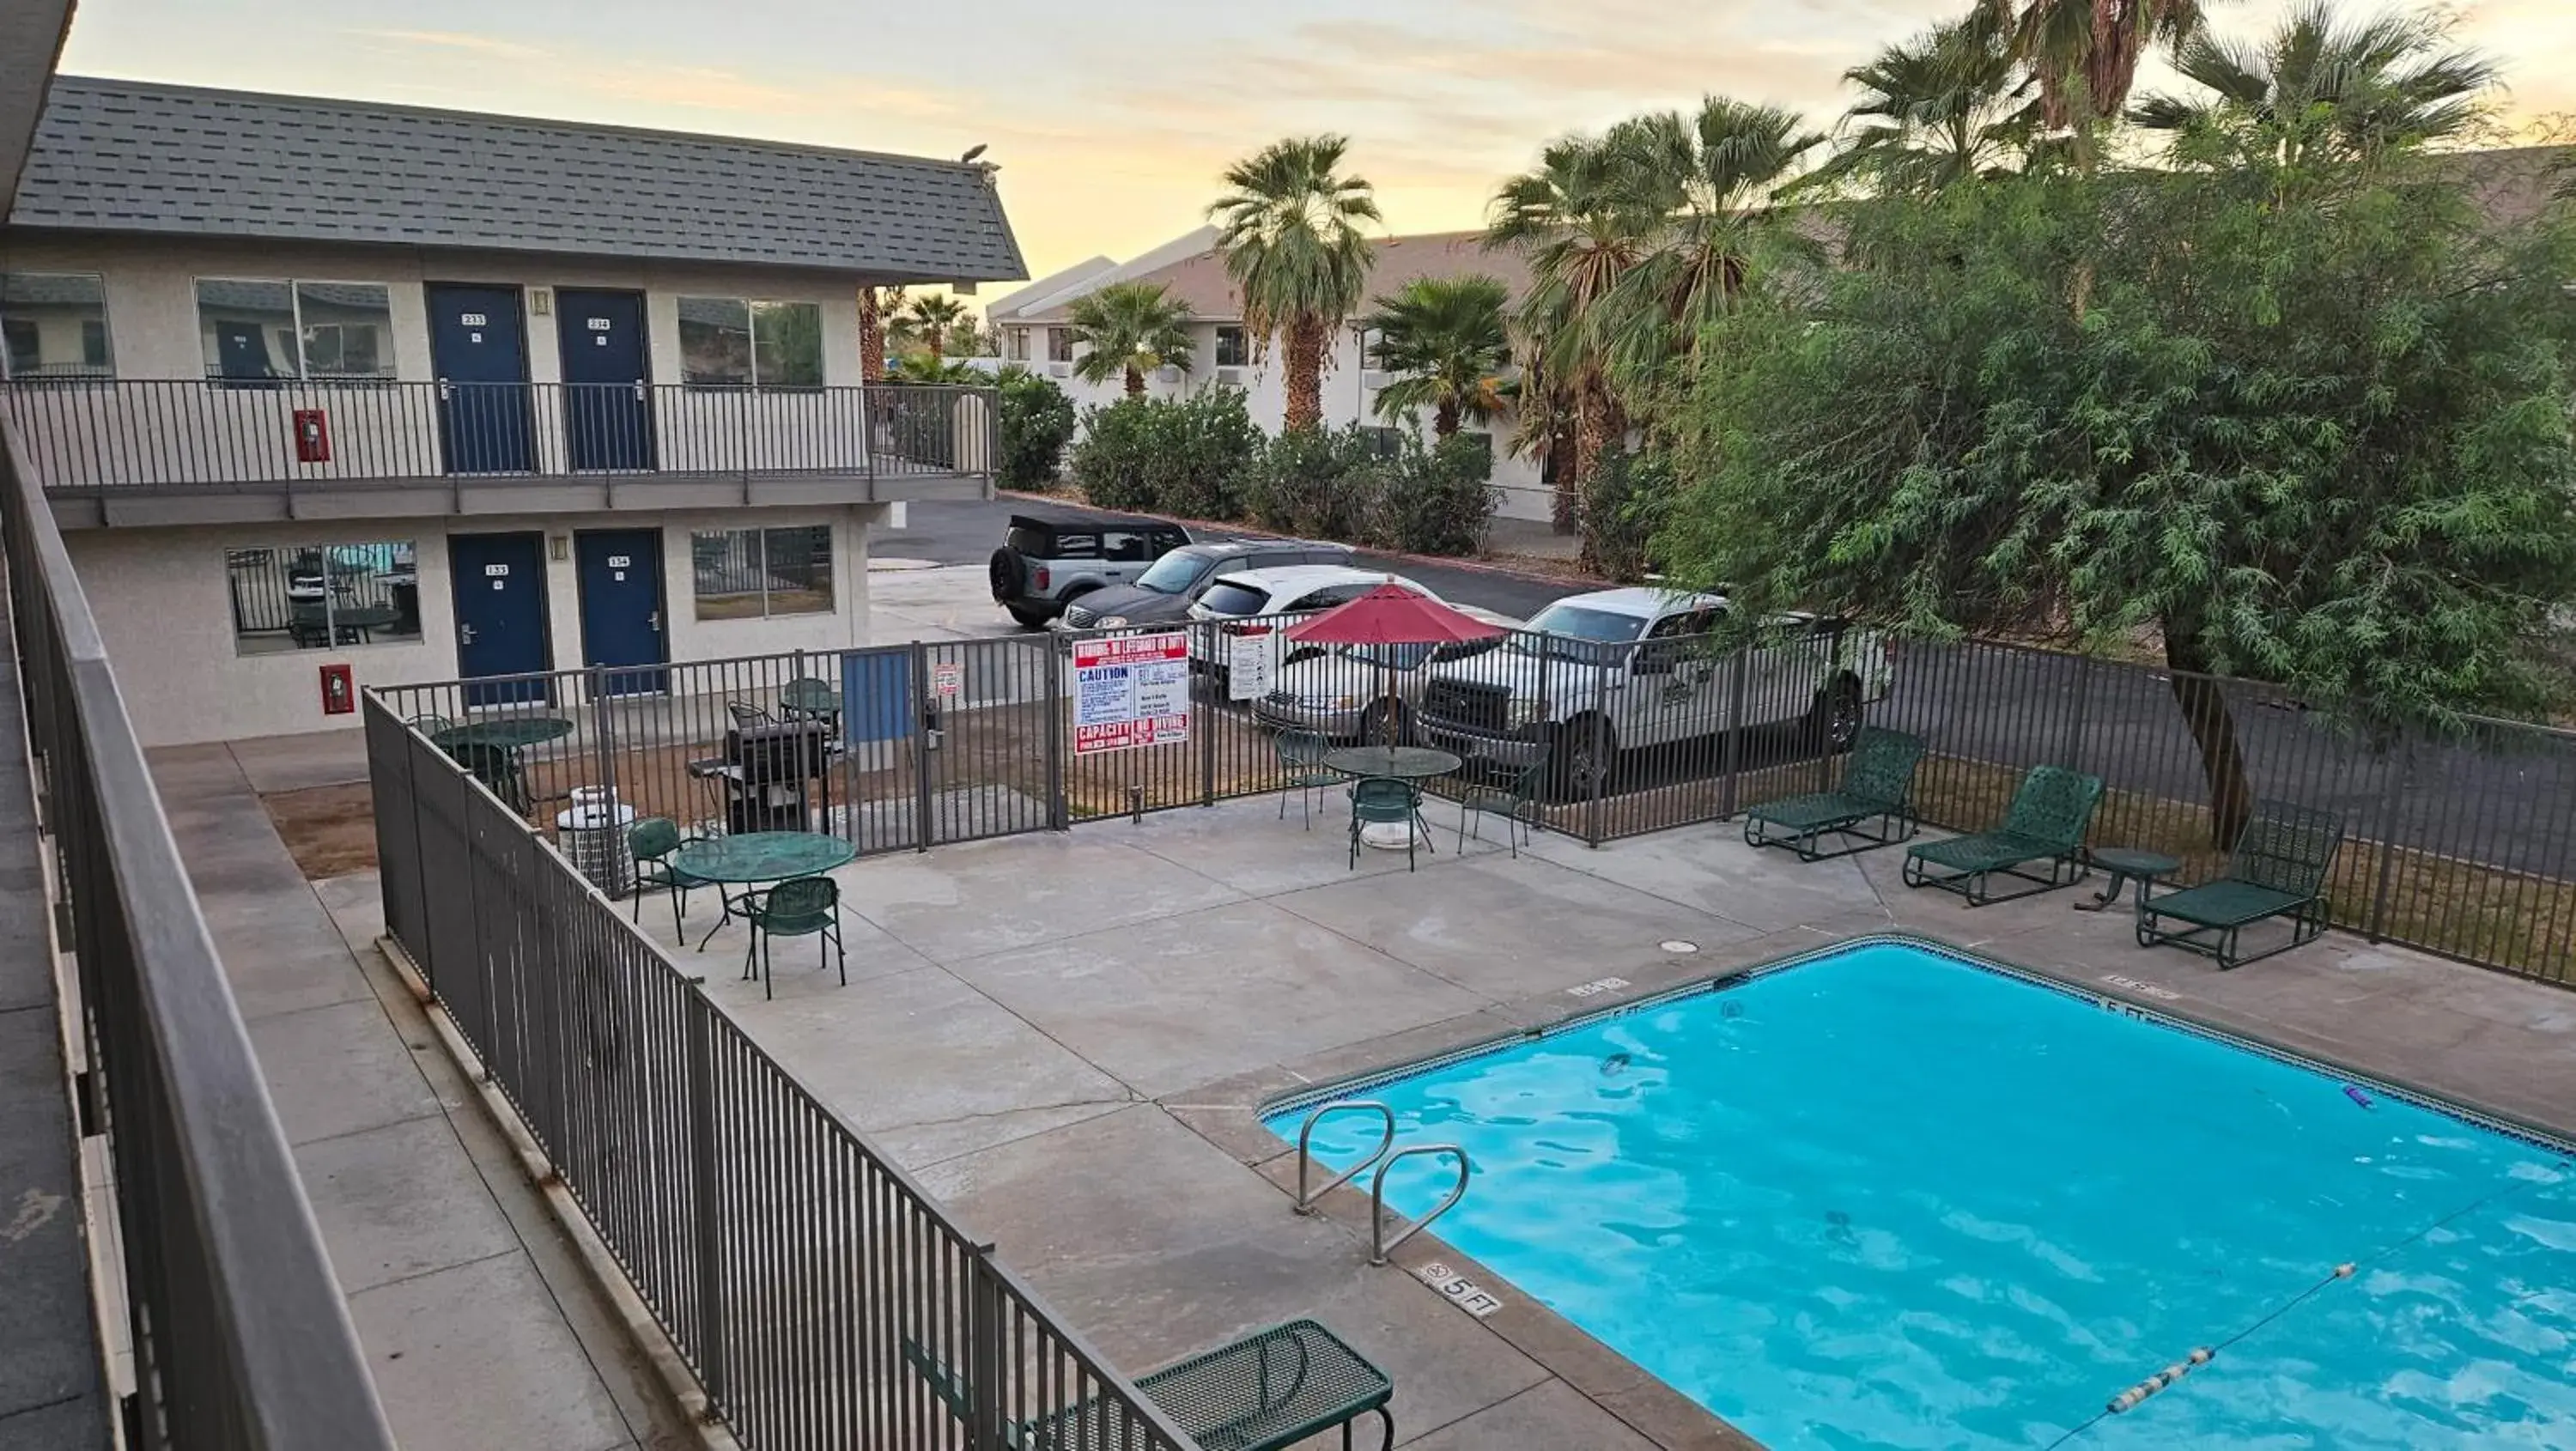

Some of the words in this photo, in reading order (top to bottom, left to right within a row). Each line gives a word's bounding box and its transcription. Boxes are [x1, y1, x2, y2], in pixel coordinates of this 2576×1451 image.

[1079, 666, 1128, 682] CAUTION
[1079, 722, 1129, 740] CAPACITY
[1137, 718, 1149, 734] NO
[1151, 714, 1183, 732] DIVING
[2125, 1006, 2144, 1021] FT
[1444, 1278, 1473, 1295] 5
[1465, 1293, 1498, 1311] FT
